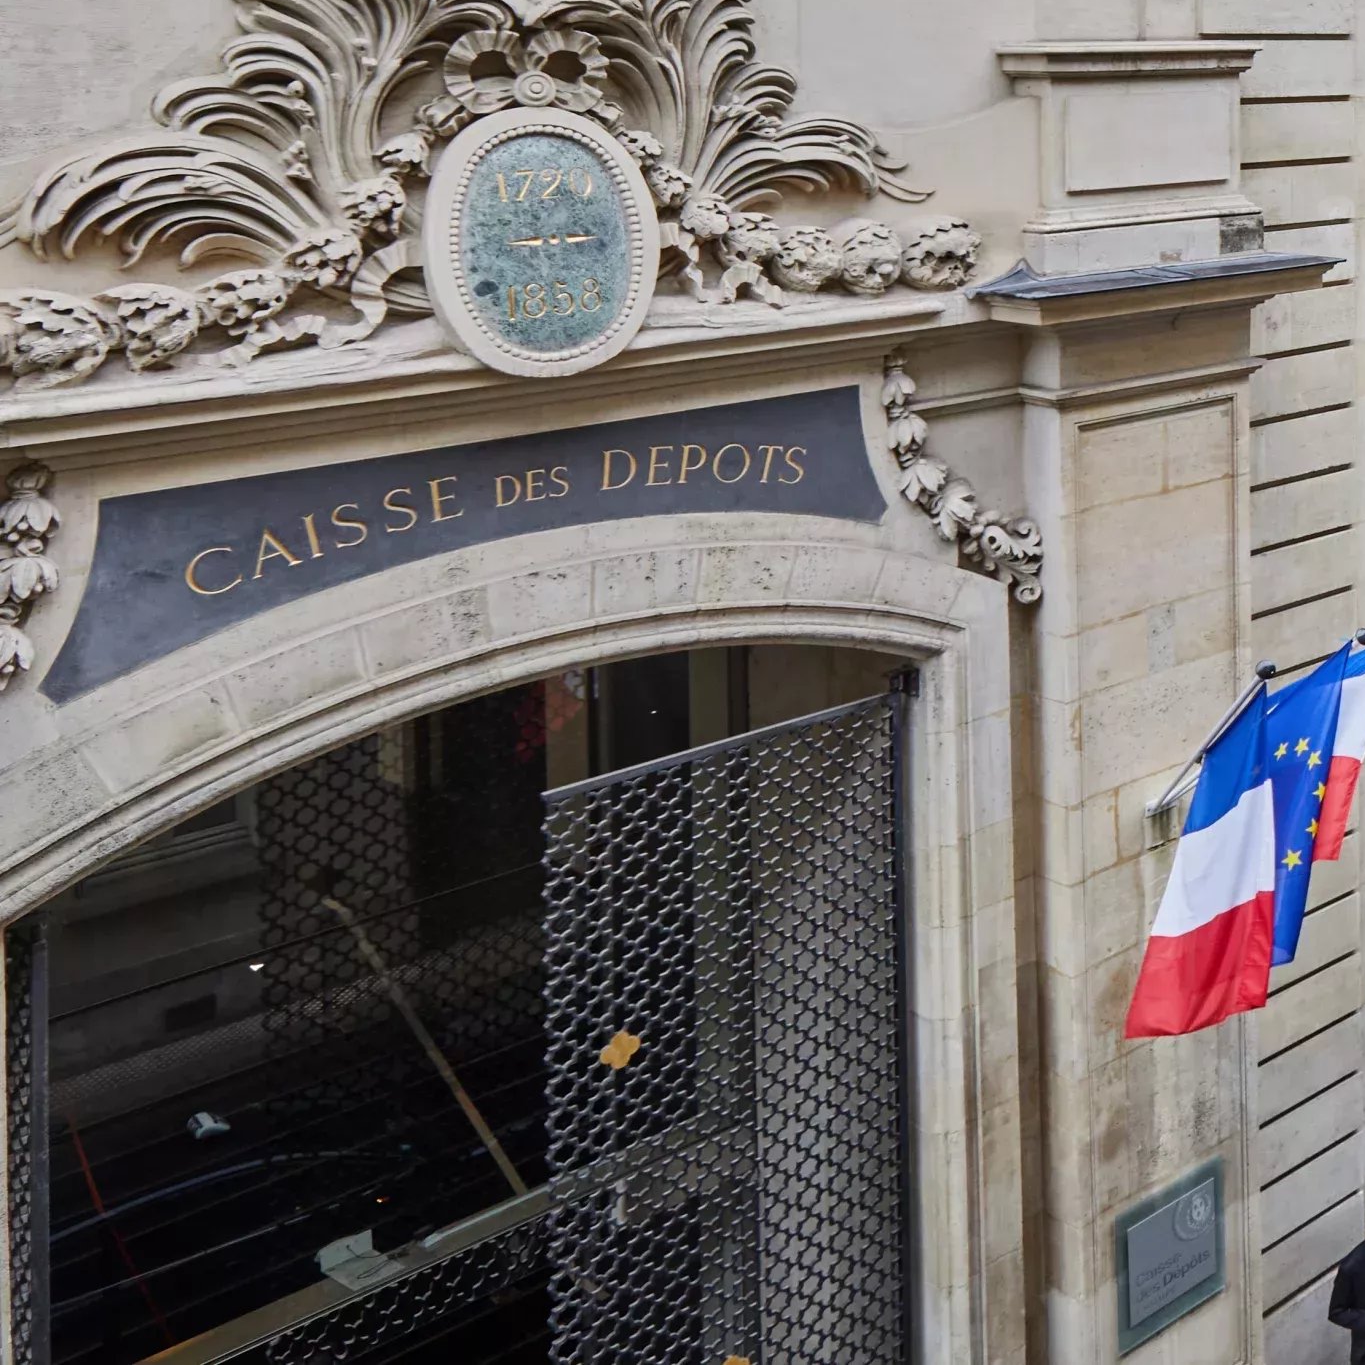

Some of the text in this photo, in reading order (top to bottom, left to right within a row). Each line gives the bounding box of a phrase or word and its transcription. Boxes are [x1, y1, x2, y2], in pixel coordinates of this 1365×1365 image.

[496, 167, 593, 203] 1720
[507, 277, 602, 322] 1858
[185, 443, 807, 595] CAISSE DES DEPOTS
